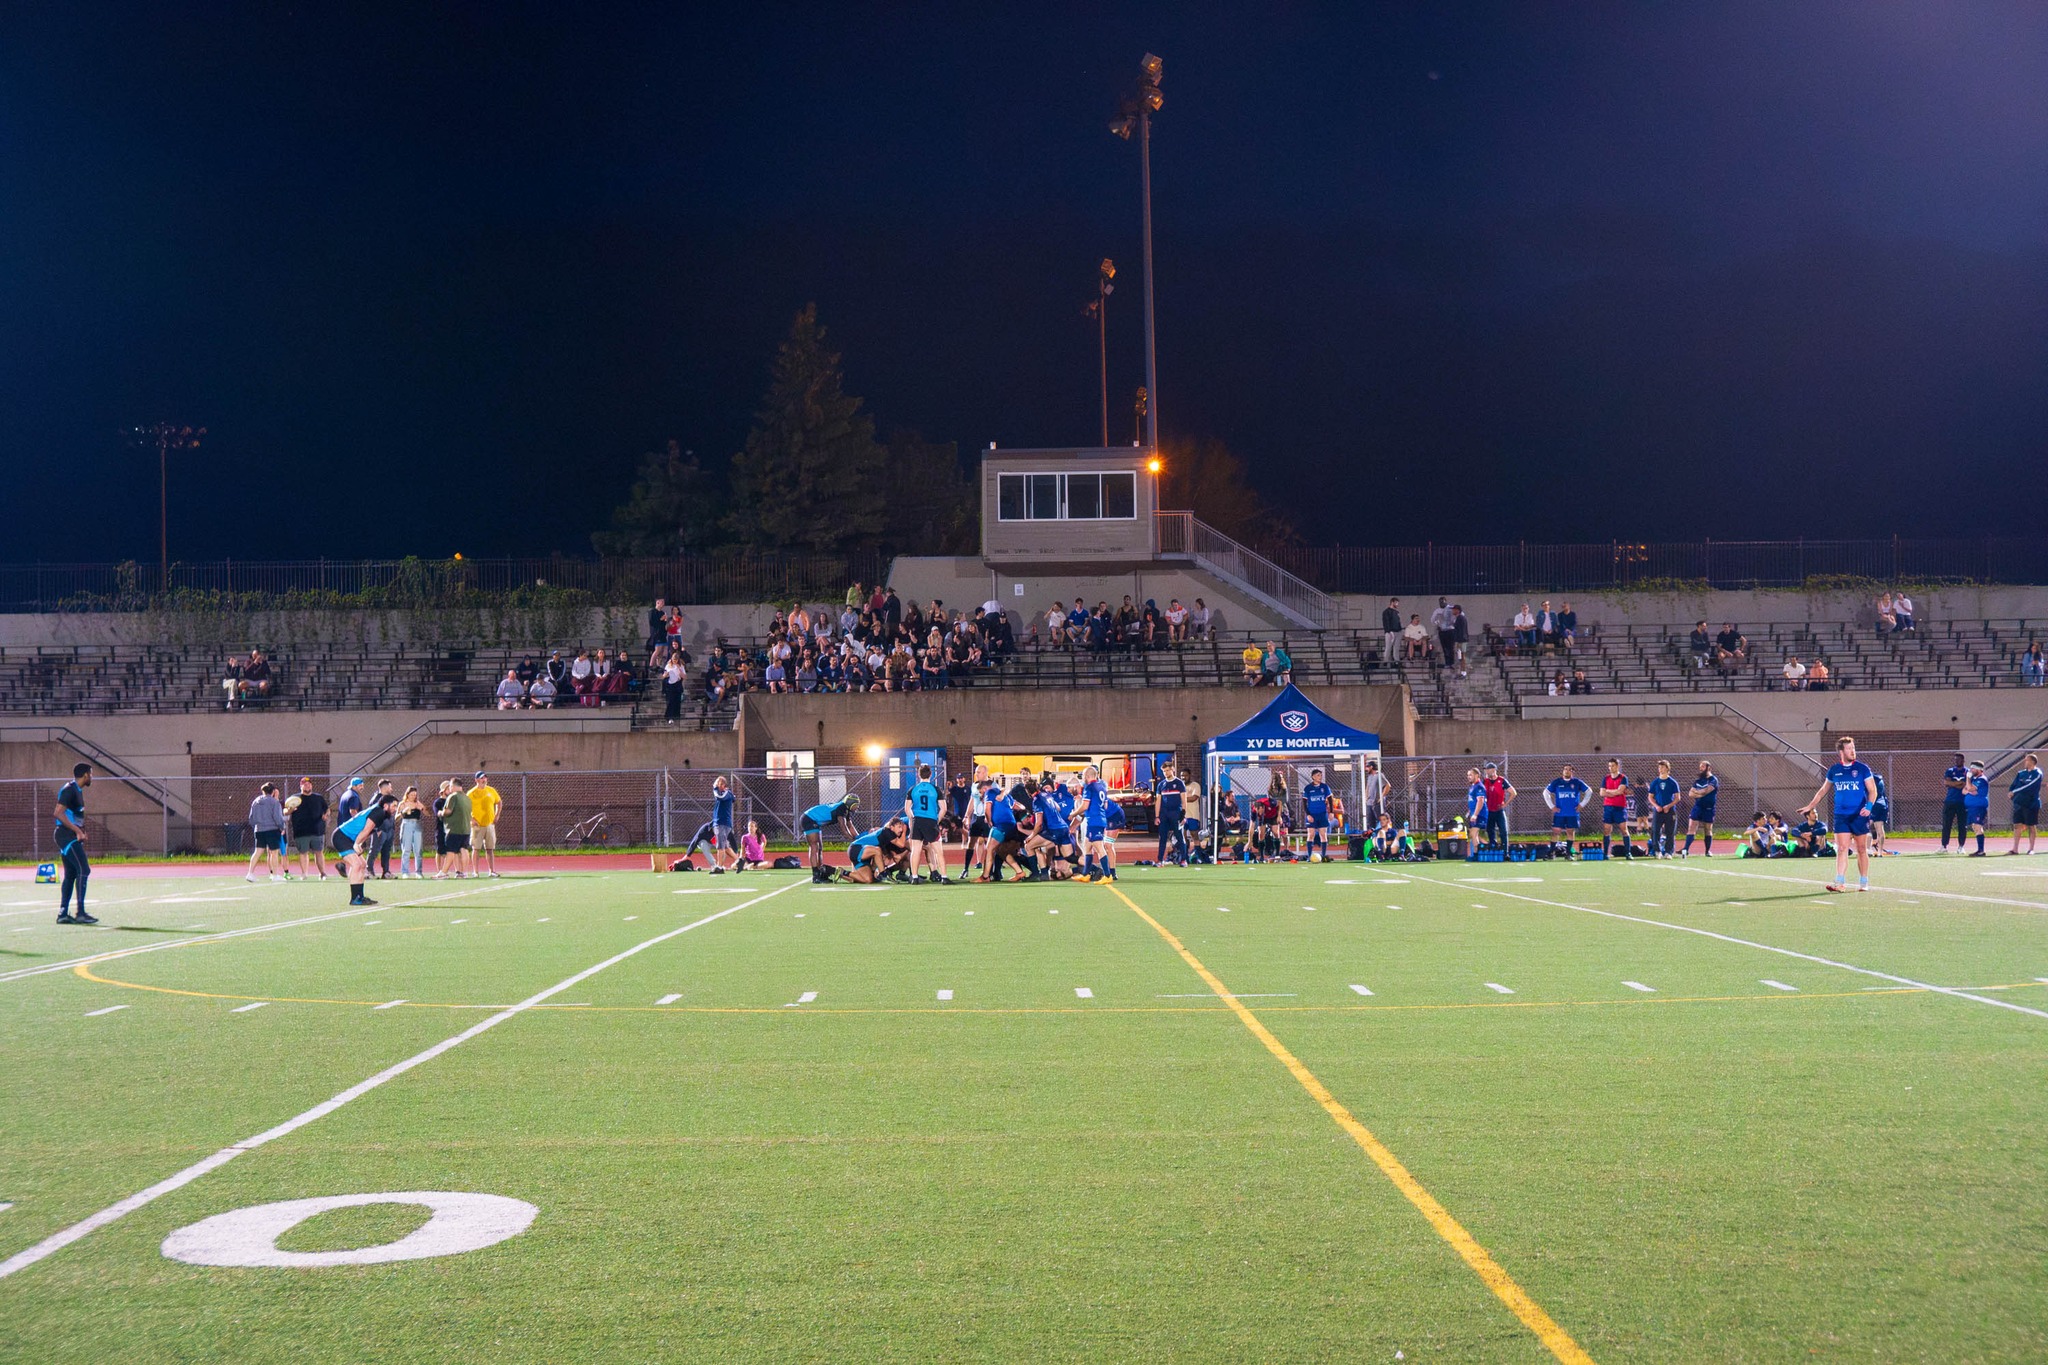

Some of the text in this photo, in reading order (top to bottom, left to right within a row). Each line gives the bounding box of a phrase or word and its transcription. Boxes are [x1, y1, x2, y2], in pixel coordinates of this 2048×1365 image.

[1247, 739, 1264, 748] XV
[1267, 739, 1283, 748] DE
[920, 795, 929, 811] 9
[1099, 790, 1105, 807] 9
